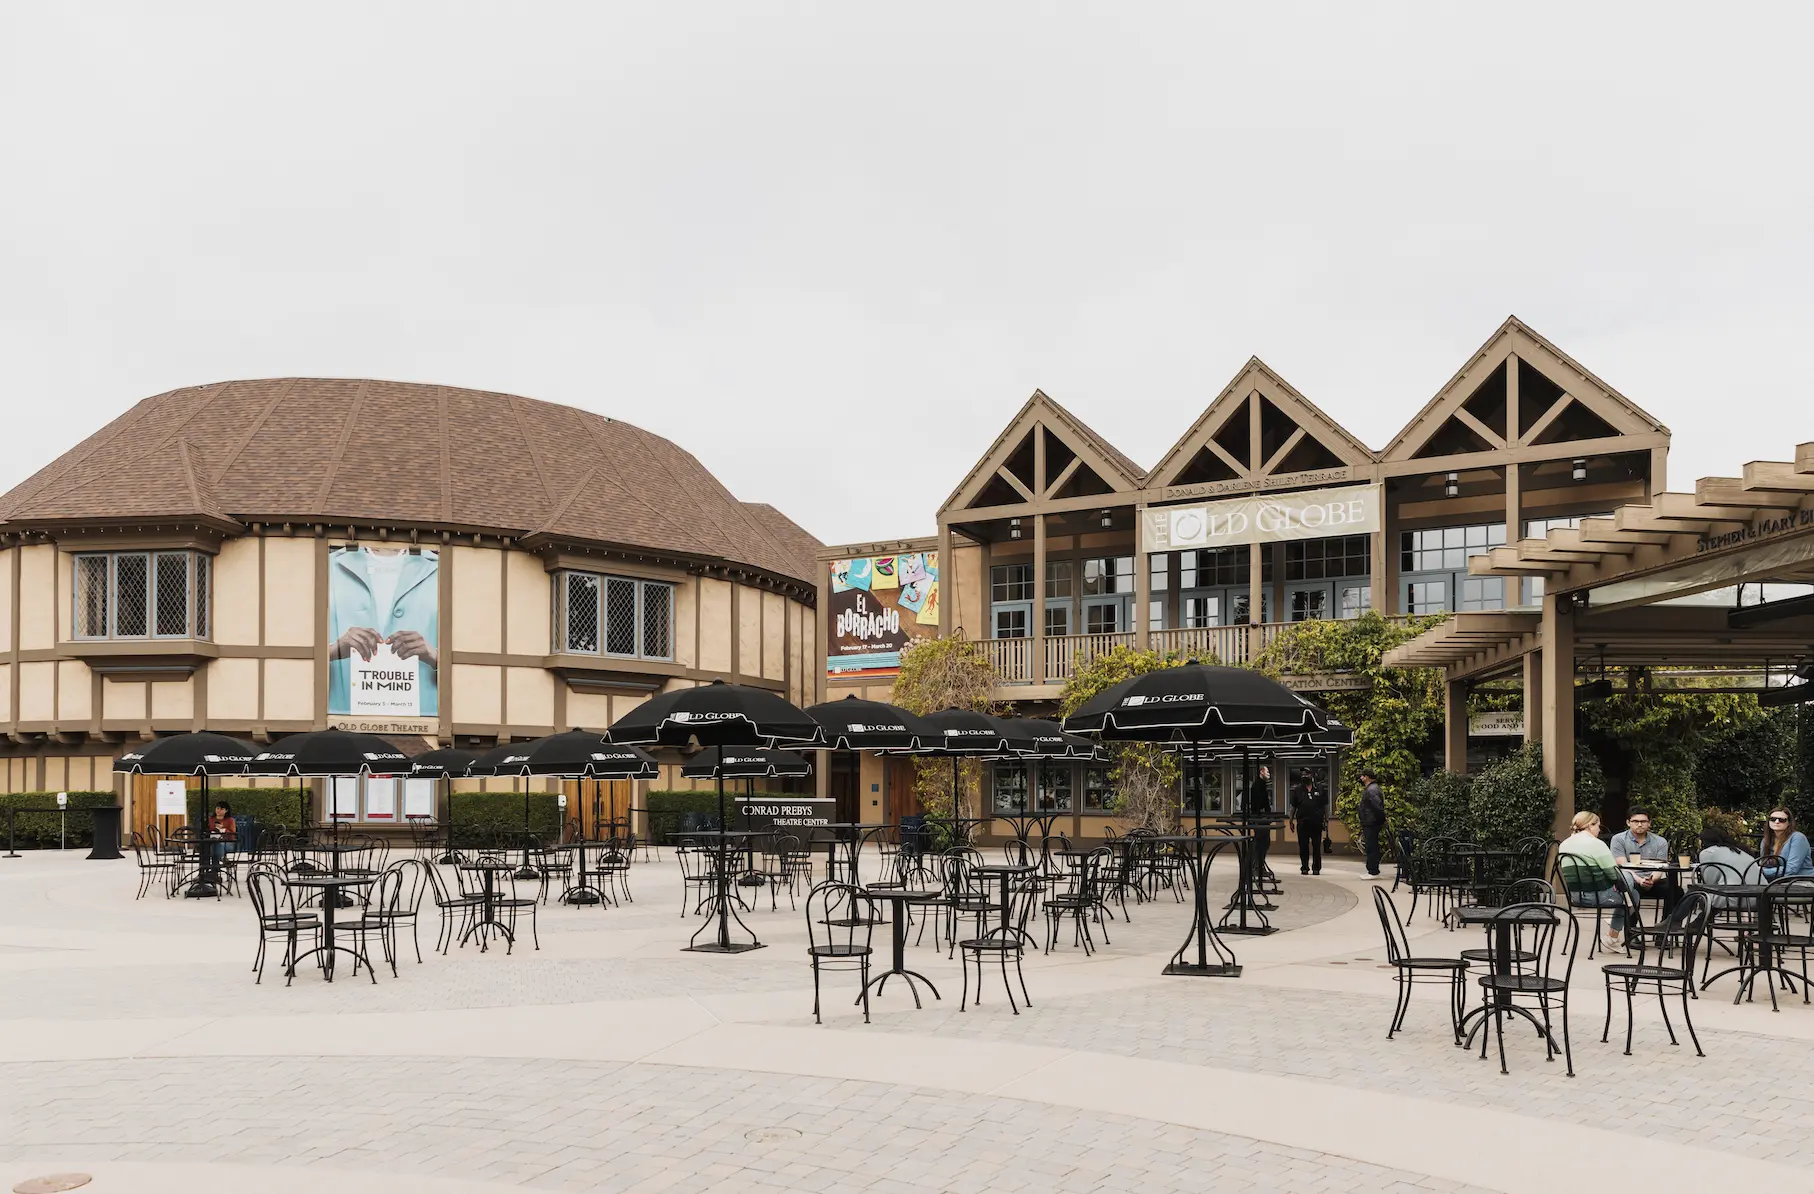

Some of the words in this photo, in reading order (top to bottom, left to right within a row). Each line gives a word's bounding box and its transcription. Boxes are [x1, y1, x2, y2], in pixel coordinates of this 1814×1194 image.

[1167, 486, 1206, 498] DONALD
[1207, 485, 1215, 494] &
[1216, 480, 1261, 493] DARLENE
[1263, 476, 1299, 488] SHILEY
[1300, 470, 1347, 484] TERRACE
[1156, 512, 1168, 545] THE
[1255, 499, 1366, 533] GLOBE
[1697, 528, 1746, 553] STEPHEN
[1757, 513, 1798, 538] MARY
[856, 594, 868, 615] EL
[837, 608, 899, 640] BORRACHO
[358, 670, 415, 681] TROUBLE
[361, 681, 373, 690] IN
[377, 681, 412, 691] MIND
[1326, 677, 1367, 688] CENTER
[1162, 693, 1205, 703] GLOBE
[338, 722, 357, 731] OLD
[360, 722, 389, 732] GLOBE
[391, 723, 429, 732] THEATRE
[875, 724, 907, 732] GLOBE
[742, 805, 780, 816] CONRAD
[781, 805, 813, 816] PREBYS
[773, 818, 803, 826] THEATRE
[803, 818, 829, 827] CENTER
